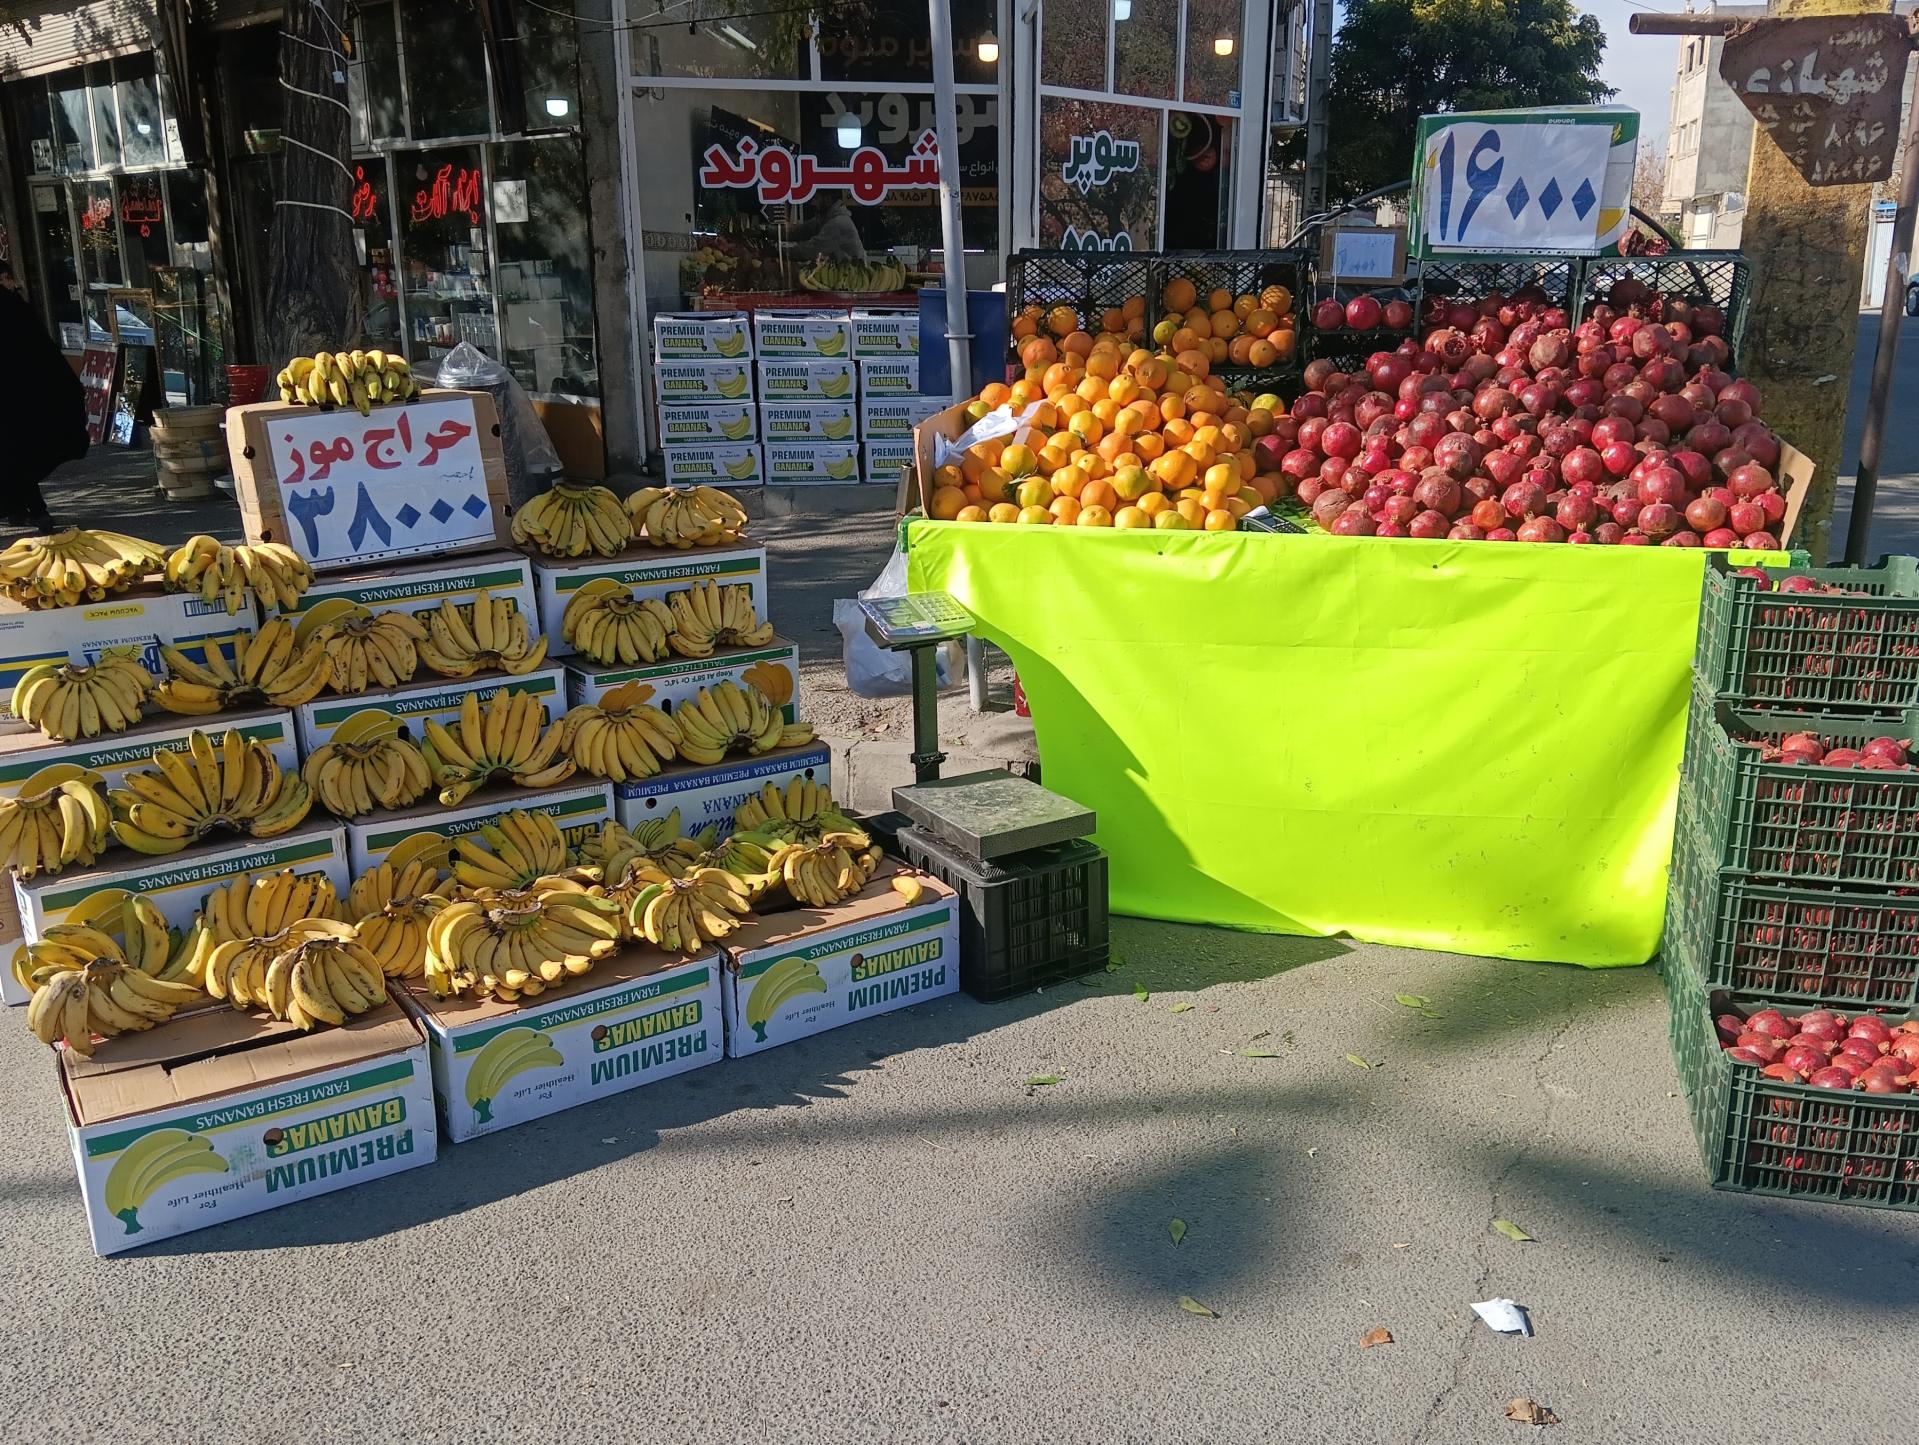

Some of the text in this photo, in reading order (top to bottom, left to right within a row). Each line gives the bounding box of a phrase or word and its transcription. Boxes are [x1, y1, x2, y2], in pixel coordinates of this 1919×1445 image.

[700, 128, 941, 205] شهروند
[969, 160, 995, 177] انواع
[1062, 130, 1140, 195] سوپر
[1439, 129, 1597, 242] ۱۶۰۰۰
[661, 326, 705, 336] PREMIUM
[761, 324, 805, 334] PREMIUM
[857, 324, 900, 333] PREMIUM
[661, 368, 705, 378] PREMIUM
[766, 367, 809, 376] PREMIUM
[867, 365, 910, 375] PREMIUM
[664, 410, 709, 420] PREMIUM
[768, 410, 811, 419] PREMIUM
[868, 407, 910, 417] PREMIUM
[282, 410, 472, 484] حراج موز
[772, 450, 815, 460] PREMIUM
[871, 447, 914, 457] PREMIUM
[671, 451, 714, 461] PREMIUM
[288, 481, 487, 558] ۳۸۰۰۰
[624, 563, 721, 583] FARM FRESH BANANAS
[360, 578, 475, 601] FARM FRESH BANANAS
[89, 606, 139, 618] VACUUM PACK
[81, 638, 120, 648] BANANAS
[671, 660, 725, 673] PALLETIZED
[713, 669, 733, 679] Keep
[395, 698, 446, 713] BANANAS
[90, 747, 151, 767] BANANAS
[627, 754, 824, 797] PREMIUM BANANA PREMIUM BANANA PREMIUM
[138, 853, 276, 891] FARM FRESH BANANAS
[810, 921, 910, 958] FARM FRESH BANANAS
[856, 938, 940, 979] BANANAS
[848, 964, 946, 1012] PREMIUM
[540, 985, 661, 1028] FARM FRESH BANANAS
[785, 1011, 800, 1021] Life
[804, 1014, 817, 1023] For
[599, 1002, 698, 1050] BANANAS
[591, 1030, 708, 1086] PREMIUM
[513, 1073, 576, 1098] Healthier Life
[196, 1079, 350, 1129] FARM FRESH BANANAS
[538, 1091, 553, 1100] For
[274, 1099, 401, 1155] BANANAS
[265, 1128, 415, 1194] PREMIUM
[167, 1179, 245, 1208] Healthier Life
[199, 1198, 217, 1209] For
